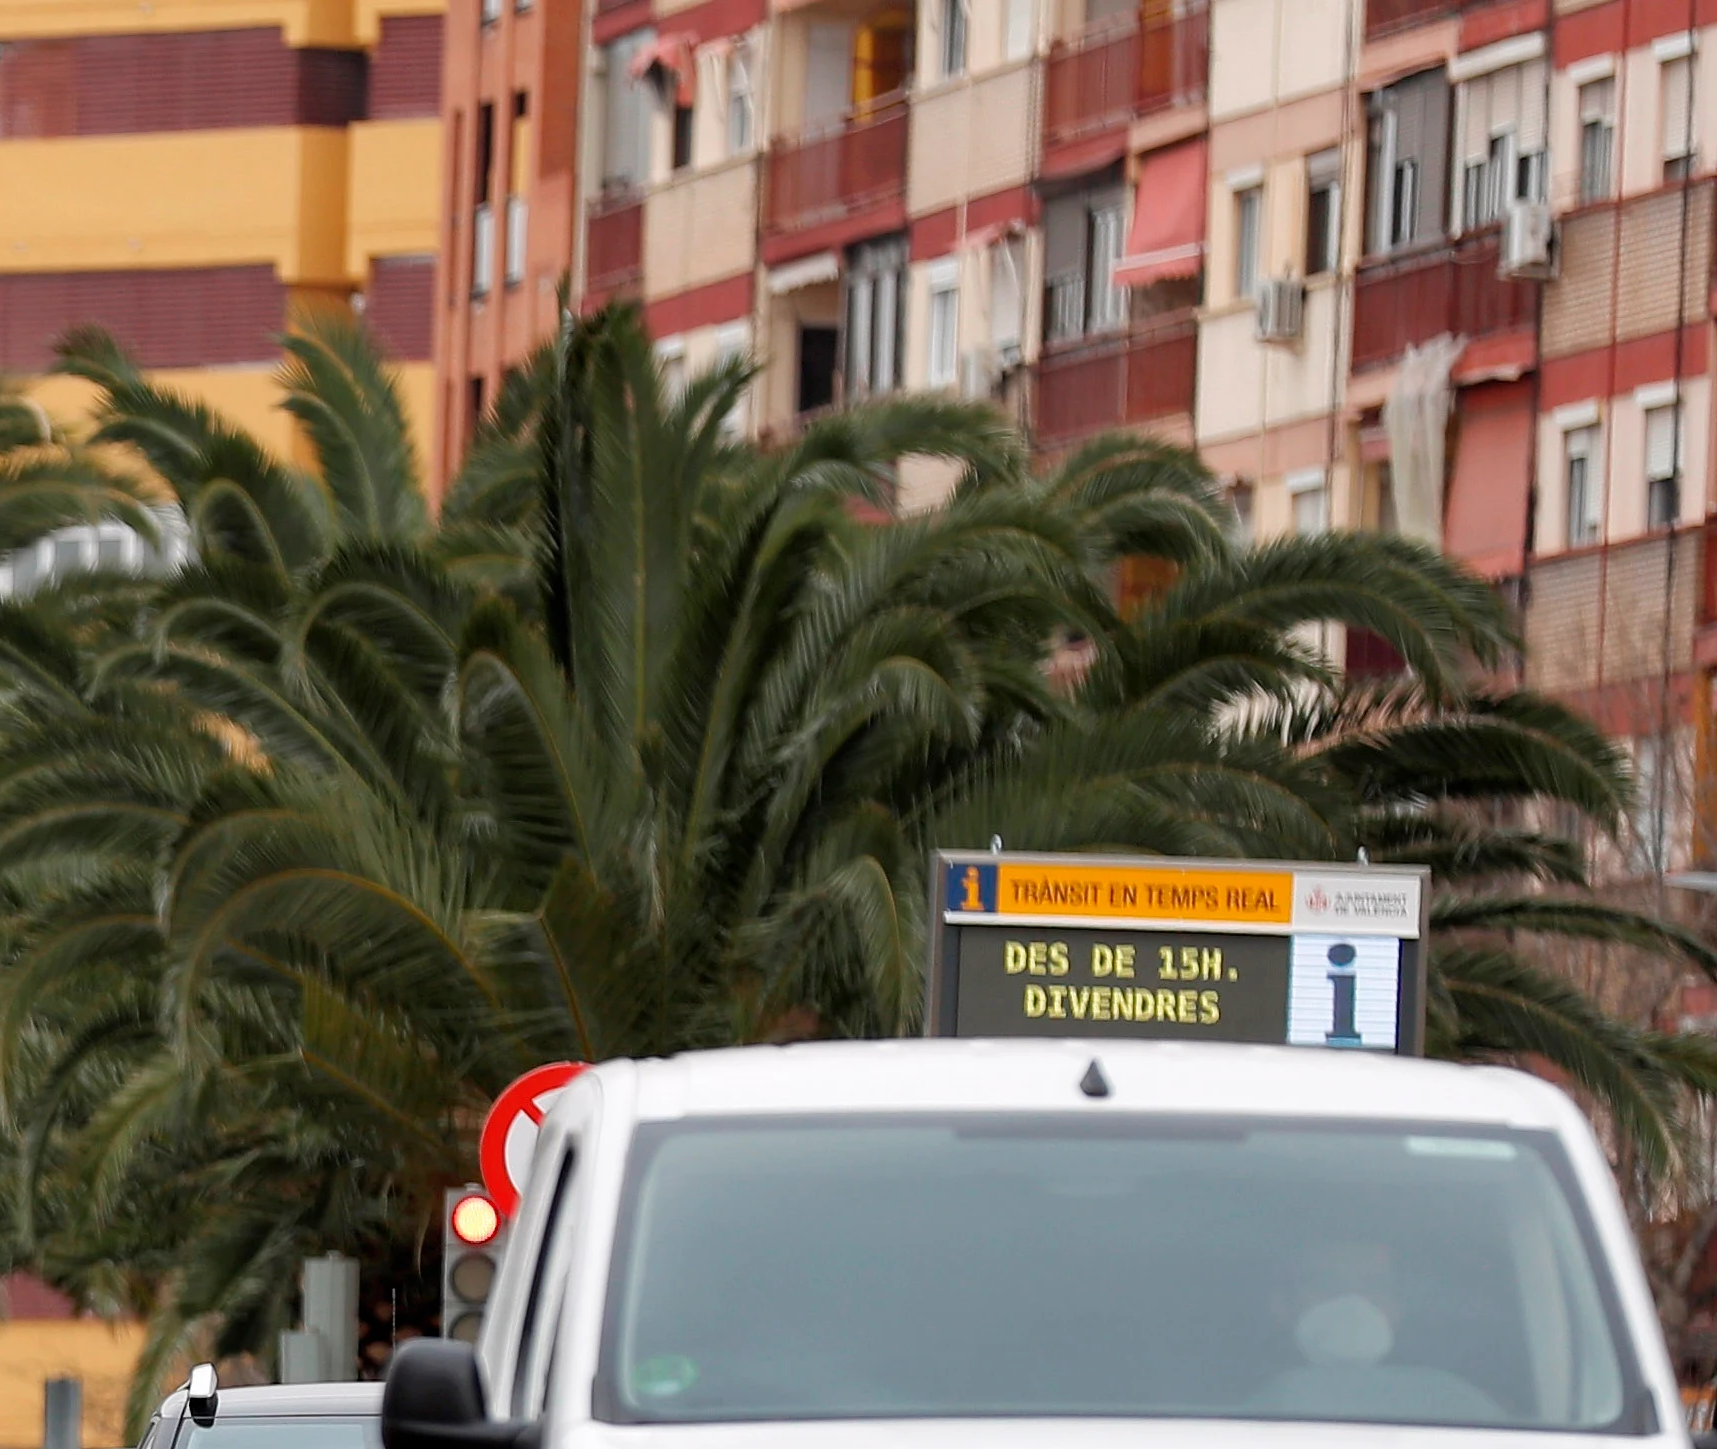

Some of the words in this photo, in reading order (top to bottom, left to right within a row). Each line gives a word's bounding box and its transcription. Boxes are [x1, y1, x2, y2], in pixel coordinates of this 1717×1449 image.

[1011, 874, 1102, 907] TRÀNSIT
[1109, 883, 1138, 909] EN
[1145, 883, 1219, 913] TEMPS
[1225, 886, 1281, 914] REAL
[1004, 939, 1070, 977] DES
[1091, 942, 1136, 979] DE
[1157, 945, 1239, 983] 15H.
[1024, 983, 1220, 1025] DIVENDRES
